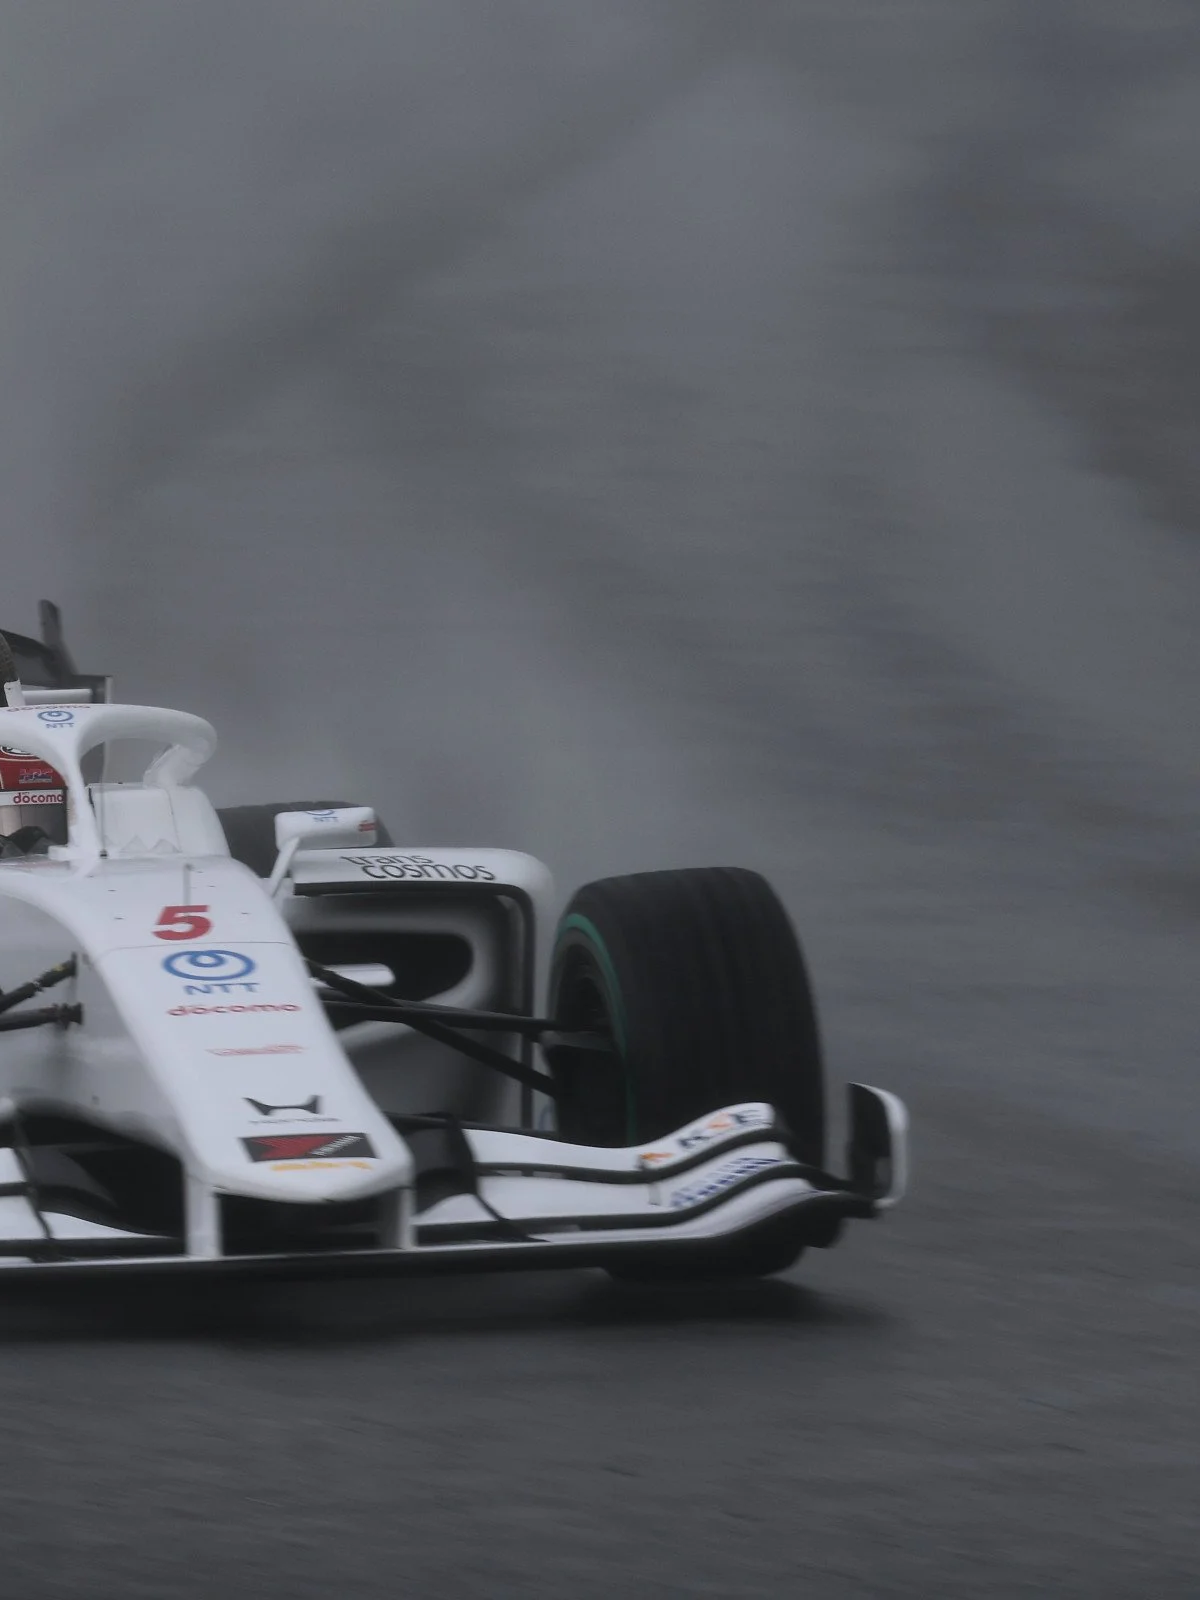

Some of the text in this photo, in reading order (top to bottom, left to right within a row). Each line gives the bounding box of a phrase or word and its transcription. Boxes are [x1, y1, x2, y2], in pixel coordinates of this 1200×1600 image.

[13, 792, 64, 804] docomo
[339, 855, 434, 866] trans
[361, 863, 495, 881] cosmos
[152, 904, 213, 941] 5
[183, 982, 260, 995] NTT
[166, 1003, 302, 1016] docomo
